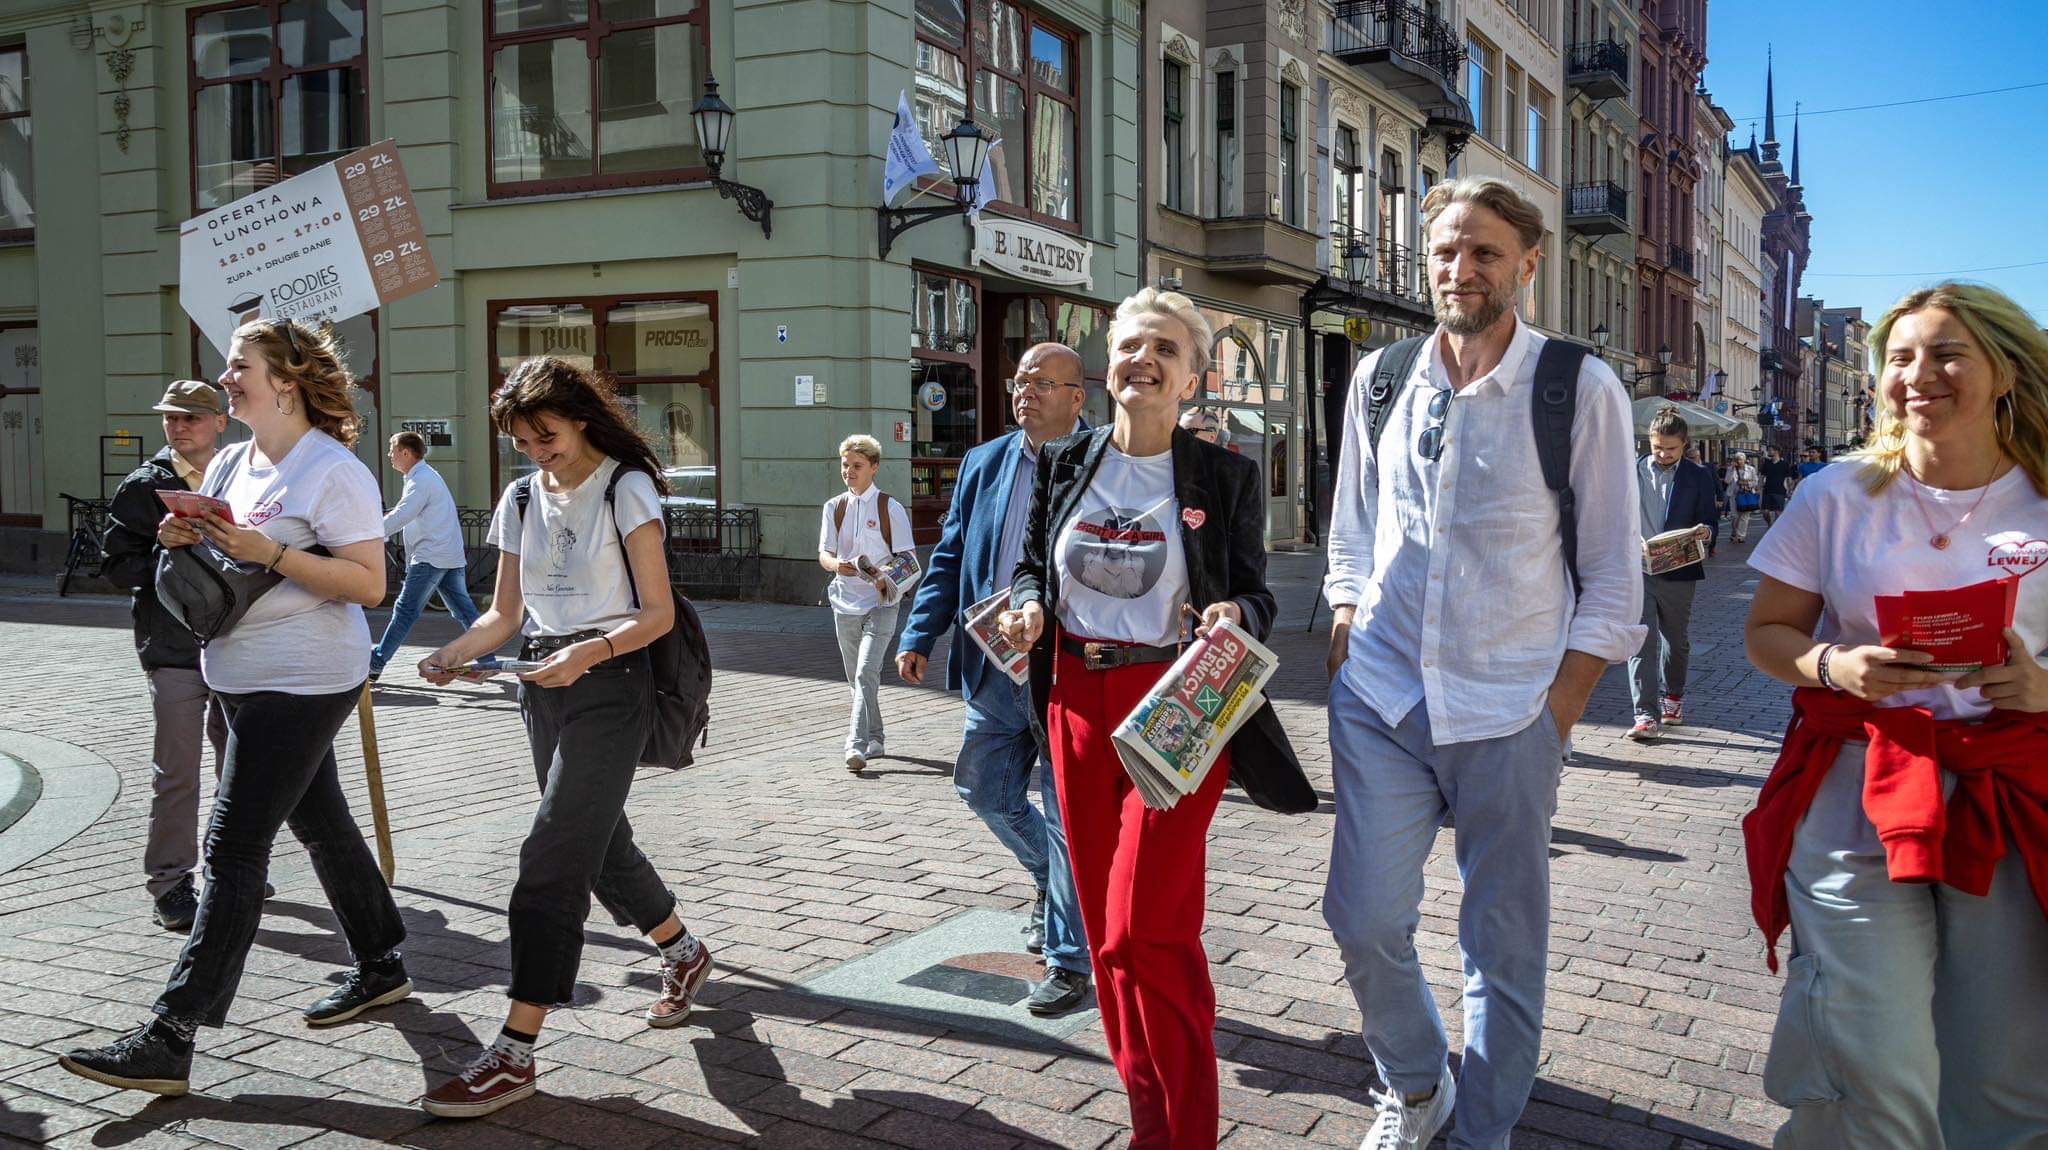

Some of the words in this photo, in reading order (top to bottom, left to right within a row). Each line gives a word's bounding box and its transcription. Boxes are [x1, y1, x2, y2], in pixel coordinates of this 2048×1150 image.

[345, 162, 366, 180] 29
[369, 153, 393, 169] ZŁ
[207, 194, 282, 230] OFERTA
[212, 196, 322, 247] LUNCHOWA
[358, 204, 380, 222] 29
[383, 195, 407, 212] ZŁ
[218, 242, 266, 268] 12:00
[294, 211, 342, 238] 17:00
[372, 249, 394, 267] 29
[398, 241, 422, 256] ZŁ
[226, 270, 253, 285] ZUPA
[265, 250, 300, 270] DRUGIE
[302, 238, 332, 255] DANIE
[270, 265, 339, 305] FOODIES
[275, 285, 343, 321] RESTAURANT
[645, 329, 701, 347] PROSTO
[401, 421, 447, 434] STREET
[1987, 556, 2038, 566] LEWEJ
[1181, 643, 1222, 701] LEWICY
[1209, 638, 1238, 680] głos
